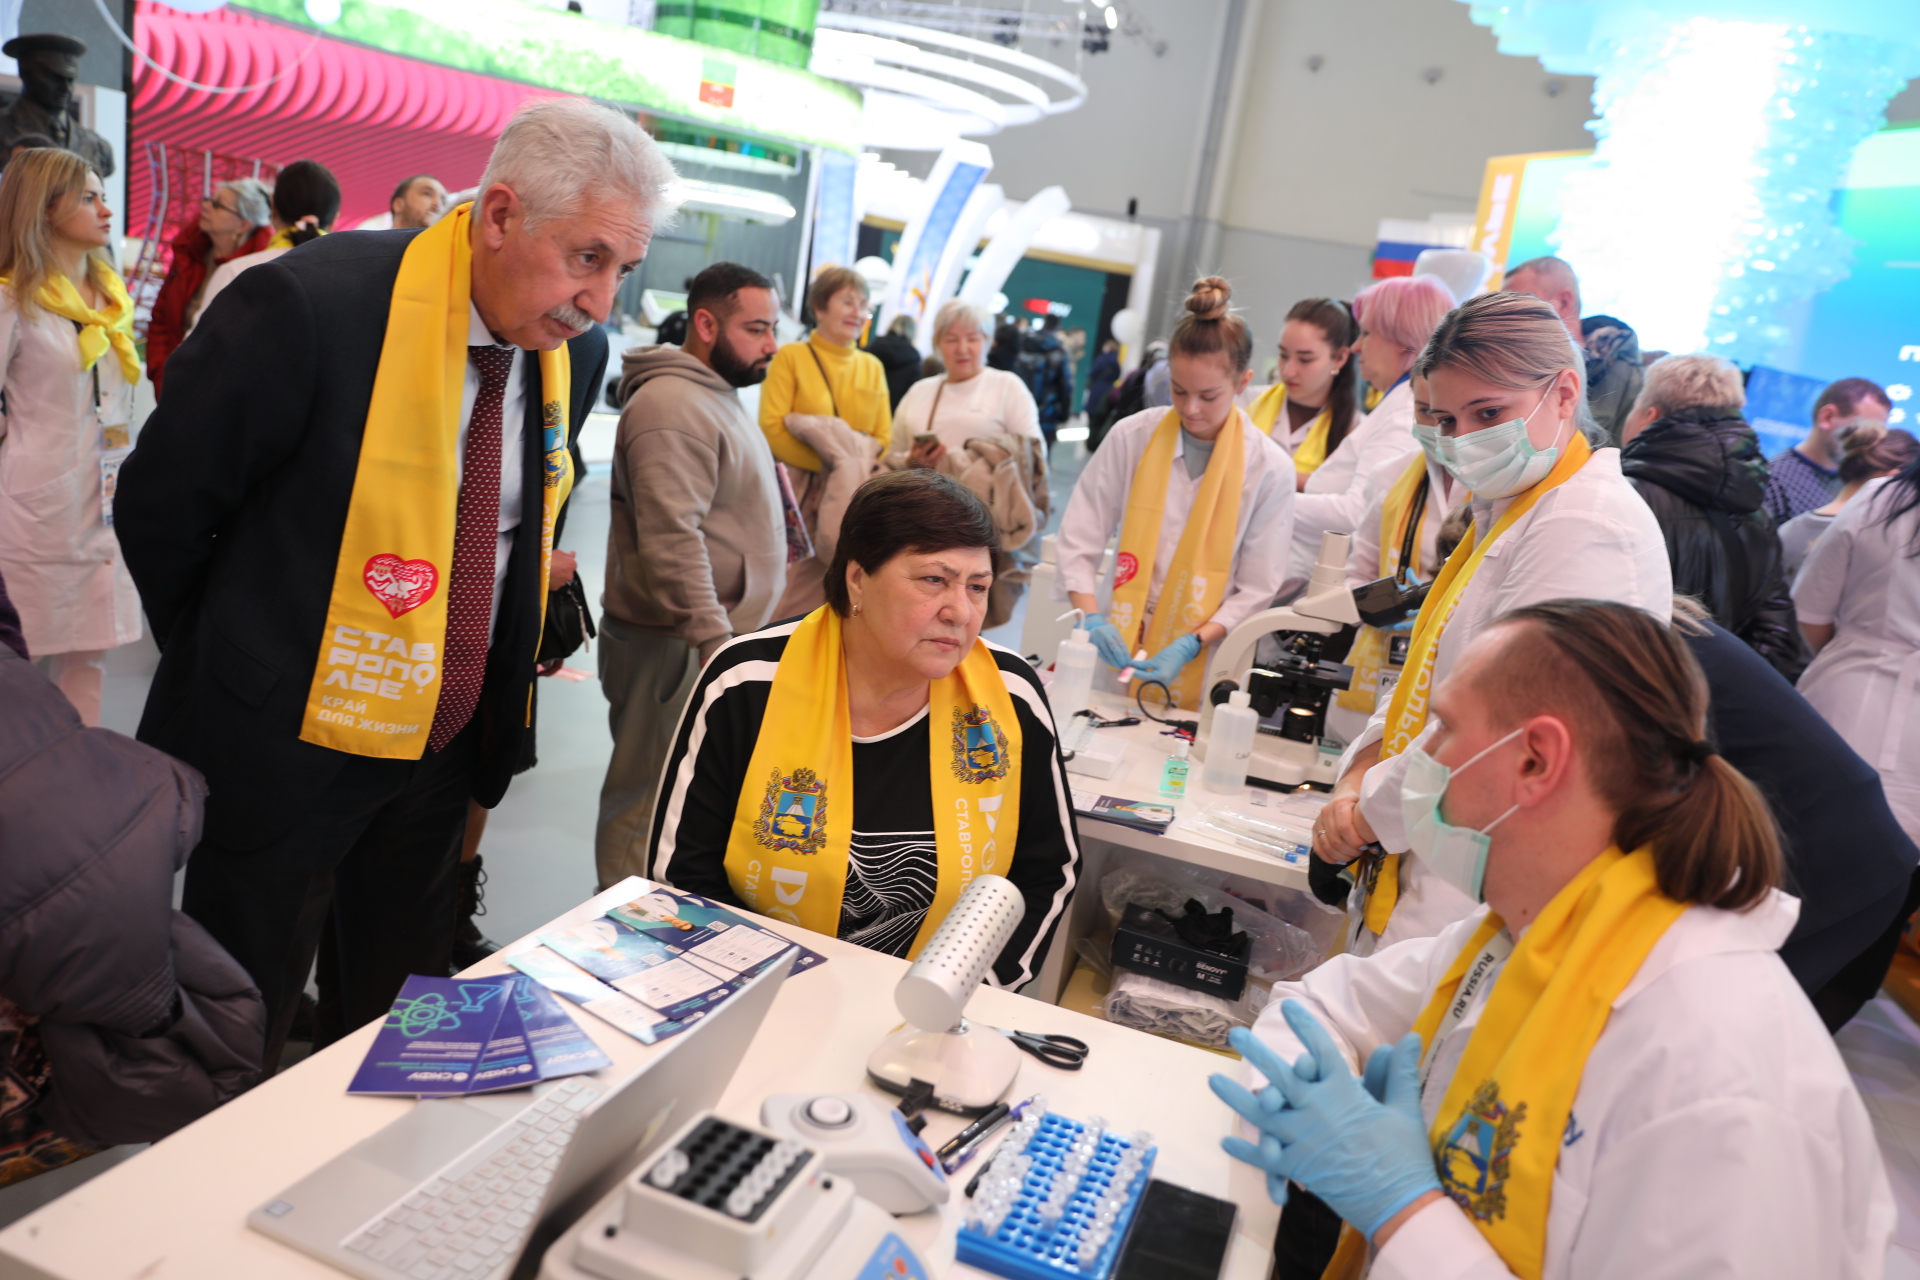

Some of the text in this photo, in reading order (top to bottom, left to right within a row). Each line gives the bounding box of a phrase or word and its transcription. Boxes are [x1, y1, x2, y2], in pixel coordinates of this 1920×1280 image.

[333, 624, 436, 661] СТАВ
[322, 669, 405, 700] ЛЬЕ
[316, 709, 419, 734] ДЛЯ ЖИЗНИ
[321, 694, 367, 715] КРАЙ
[954, 797, 974, 899] СТАВРОПО
[1453, 951, 1495, 1020] RUSSIA.RU
